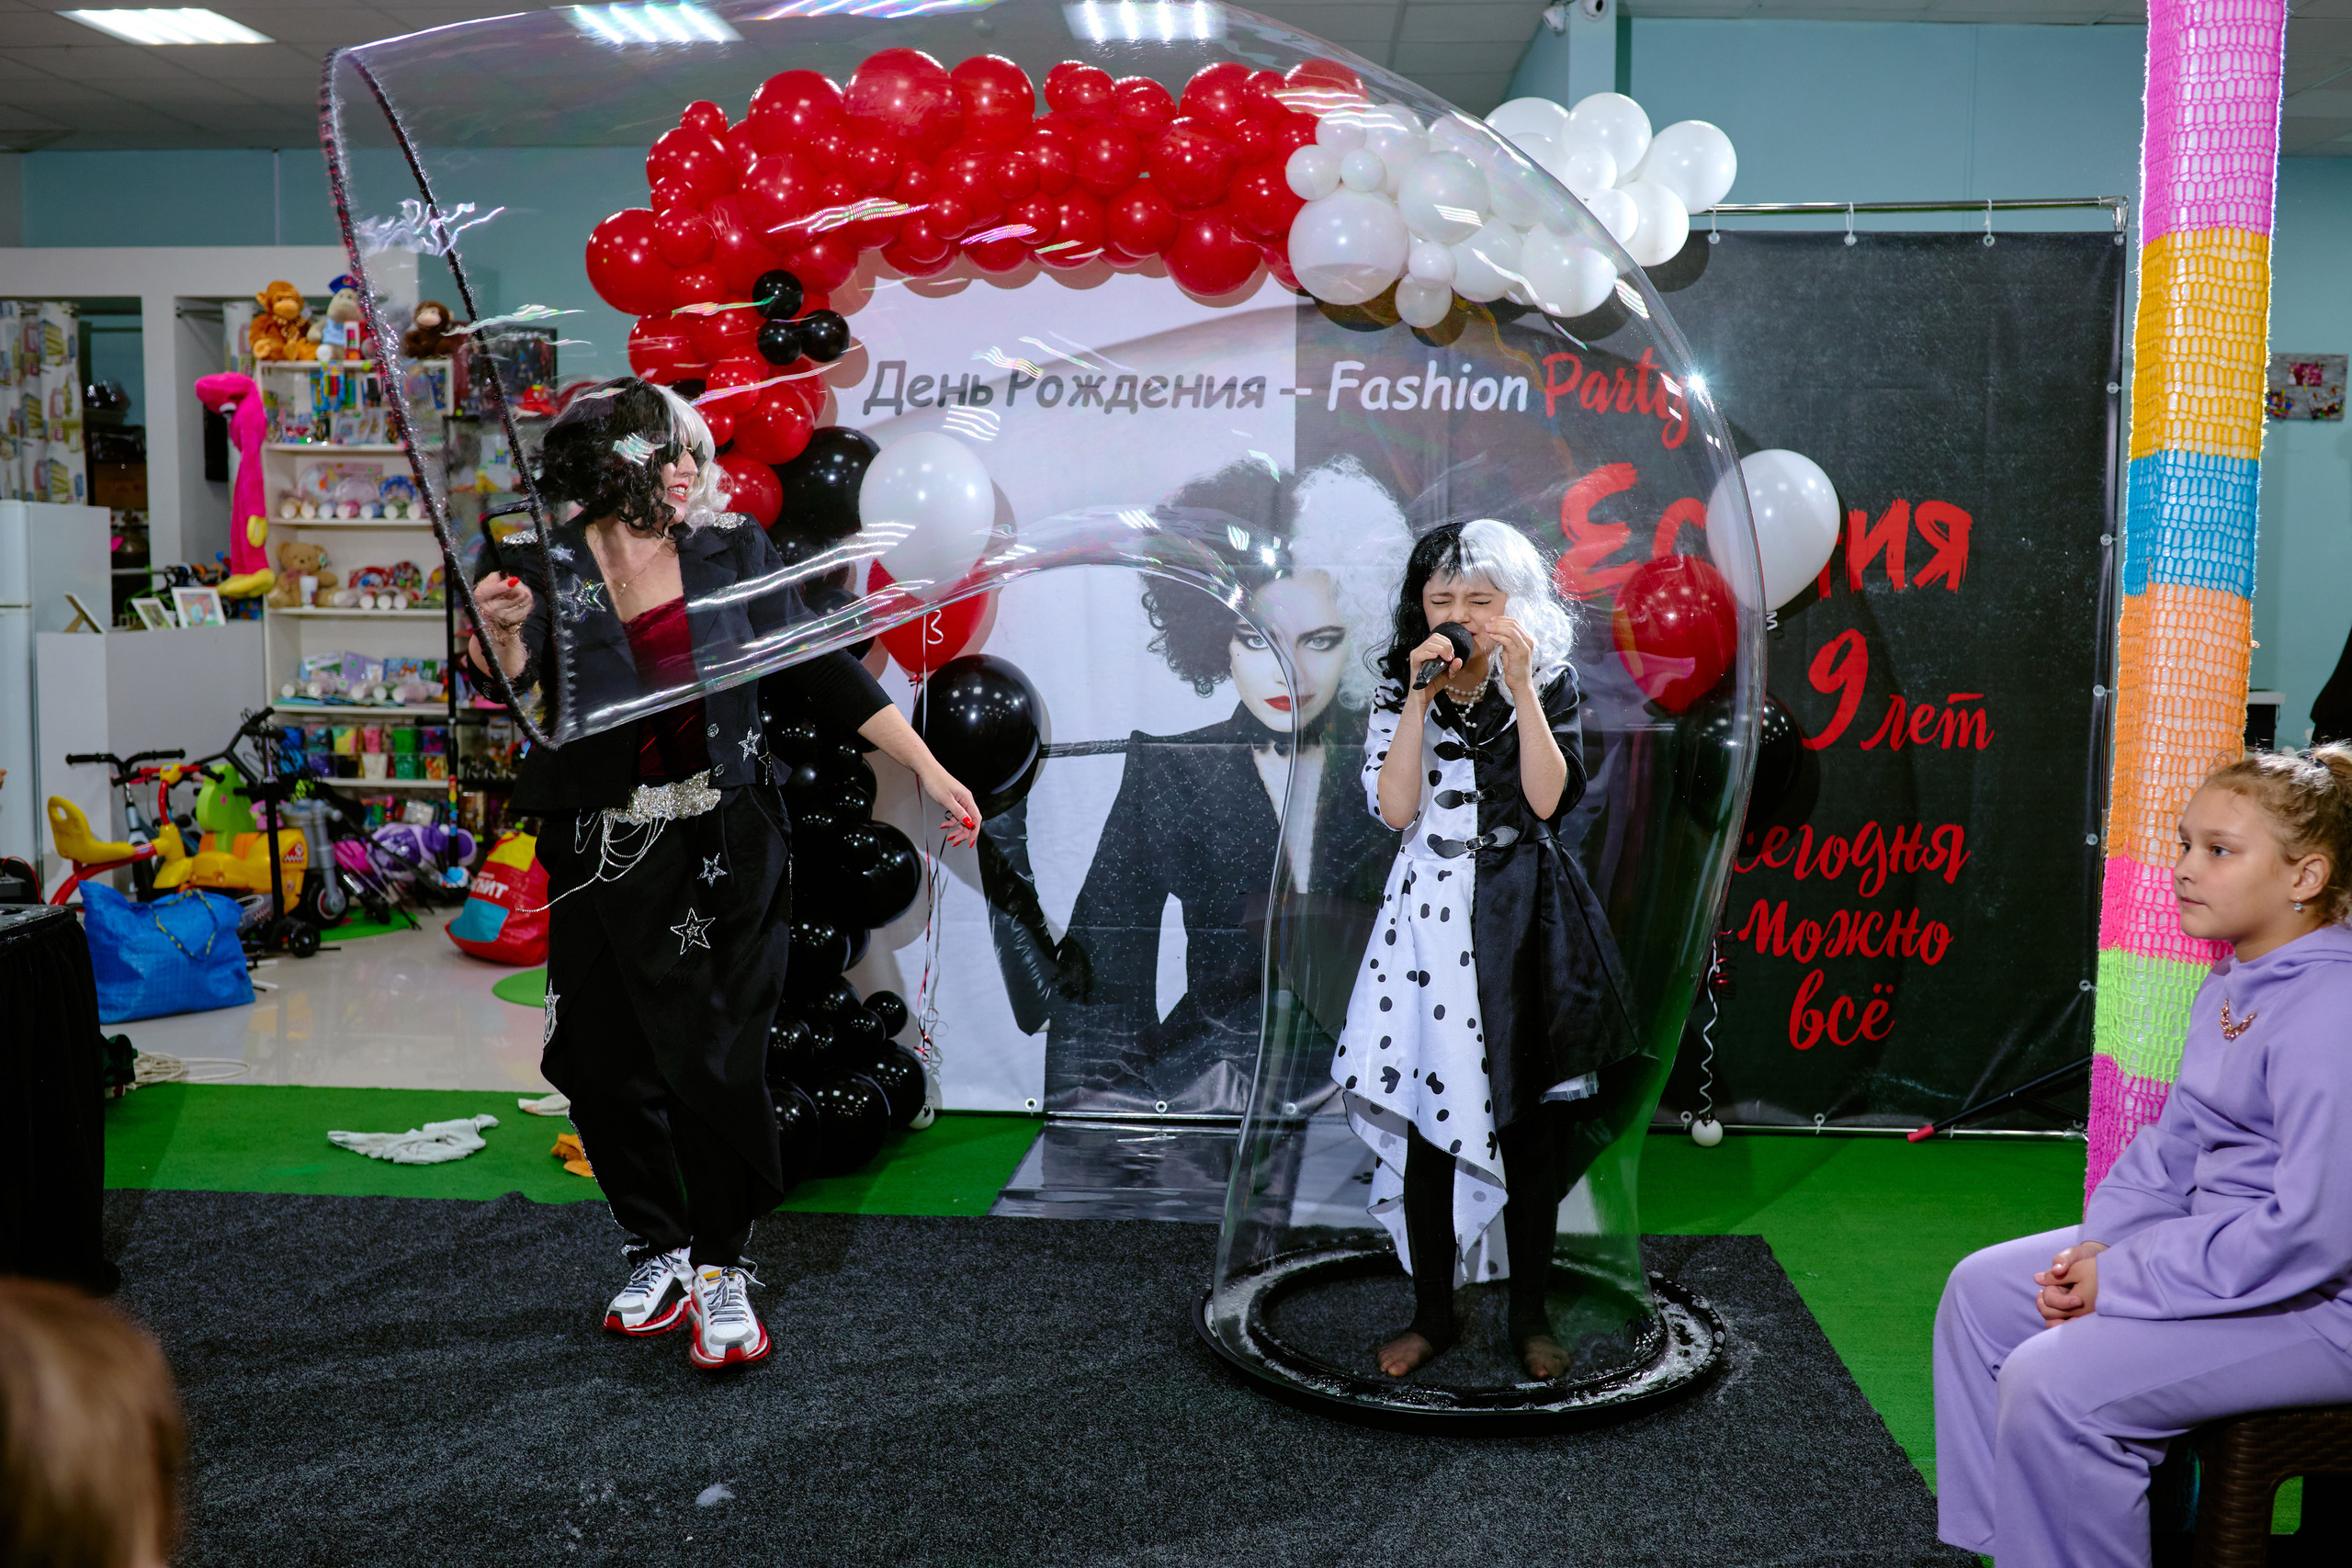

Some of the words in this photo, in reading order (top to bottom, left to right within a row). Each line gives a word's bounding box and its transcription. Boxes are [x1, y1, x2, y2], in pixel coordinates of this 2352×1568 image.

[863, 359, 994, 417] День
[1004, 364, 1267, 417] Рождения
[1327, 359, 1529, 412] Fashion
[1543, 348, 1690, 449] Party
[1803, 629, 1869, 750] 9
[1860, 693, 1996, 751] лет
[1789, 968, 1895, 1051] всё
